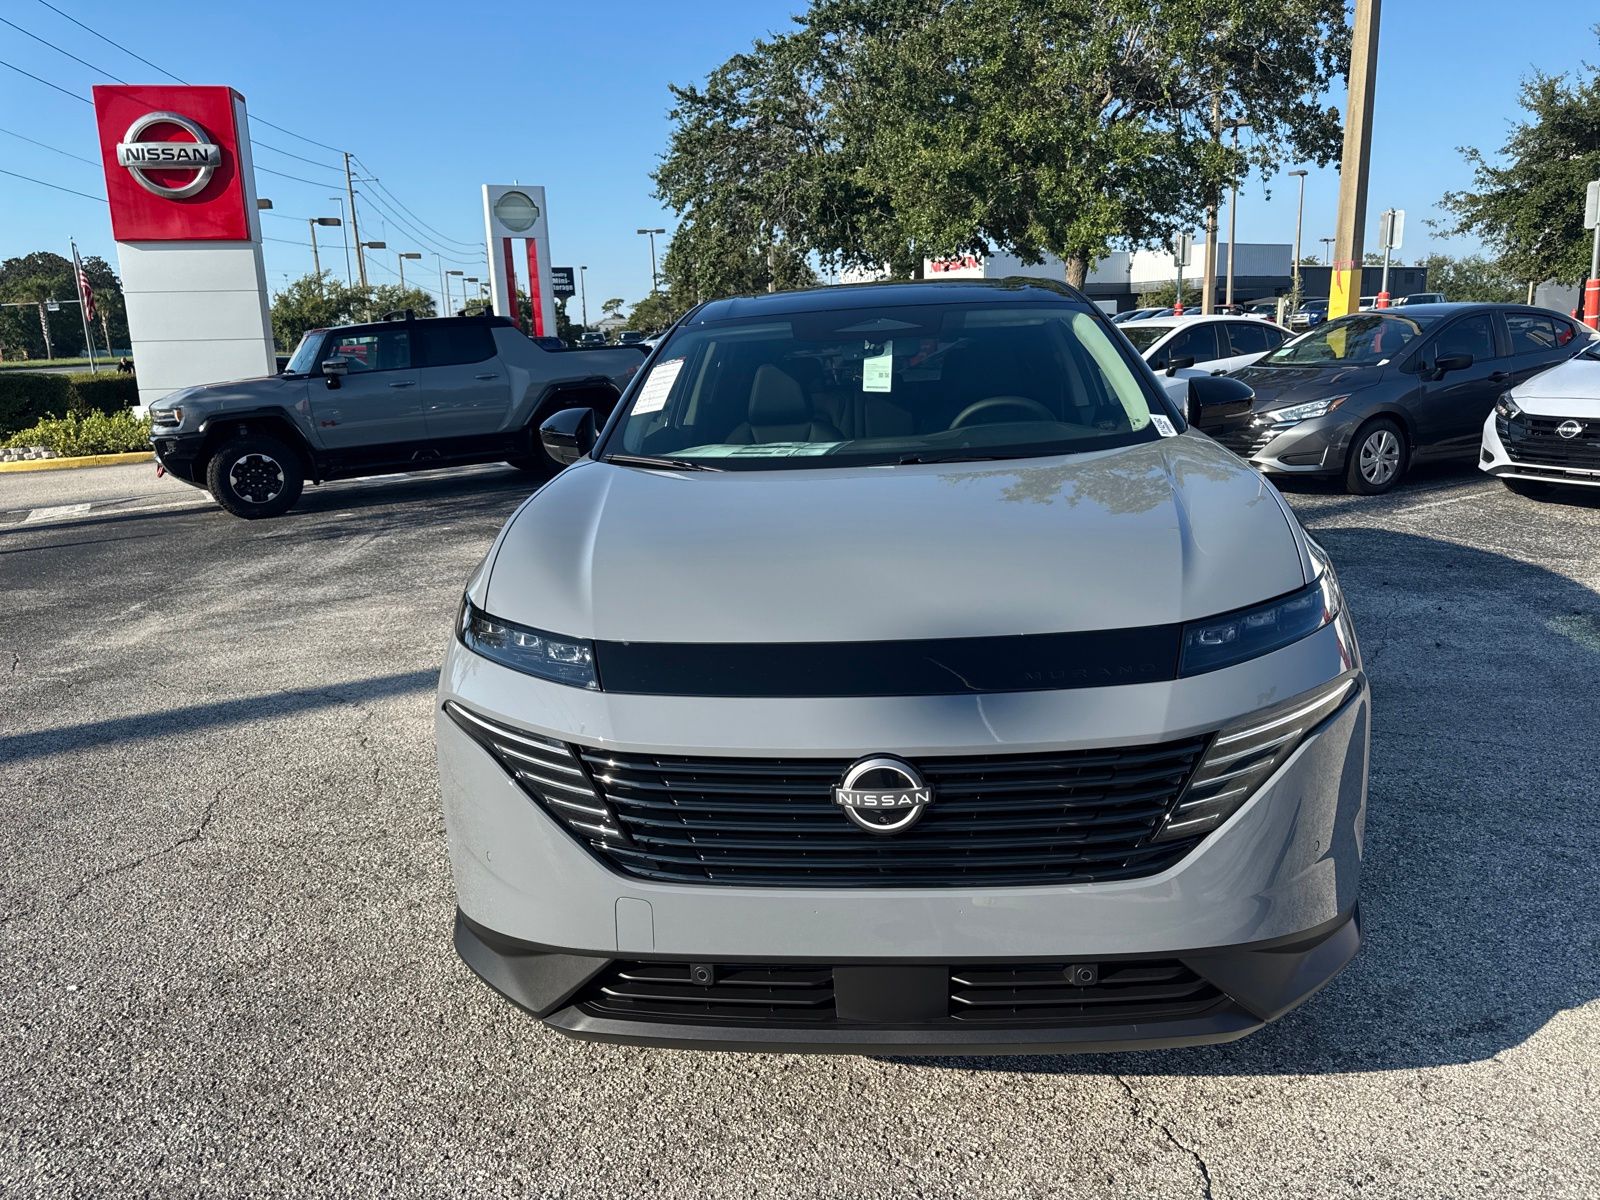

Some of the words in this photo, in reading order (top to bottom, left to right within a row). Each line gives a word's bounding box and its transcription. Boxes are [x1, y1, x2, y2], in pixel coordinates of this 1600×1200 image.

[125, 148, 208, 161] NISSAN
[1024, 663, 1158, 681] MURANO
[838, 790, 929, 806] NISSAN
